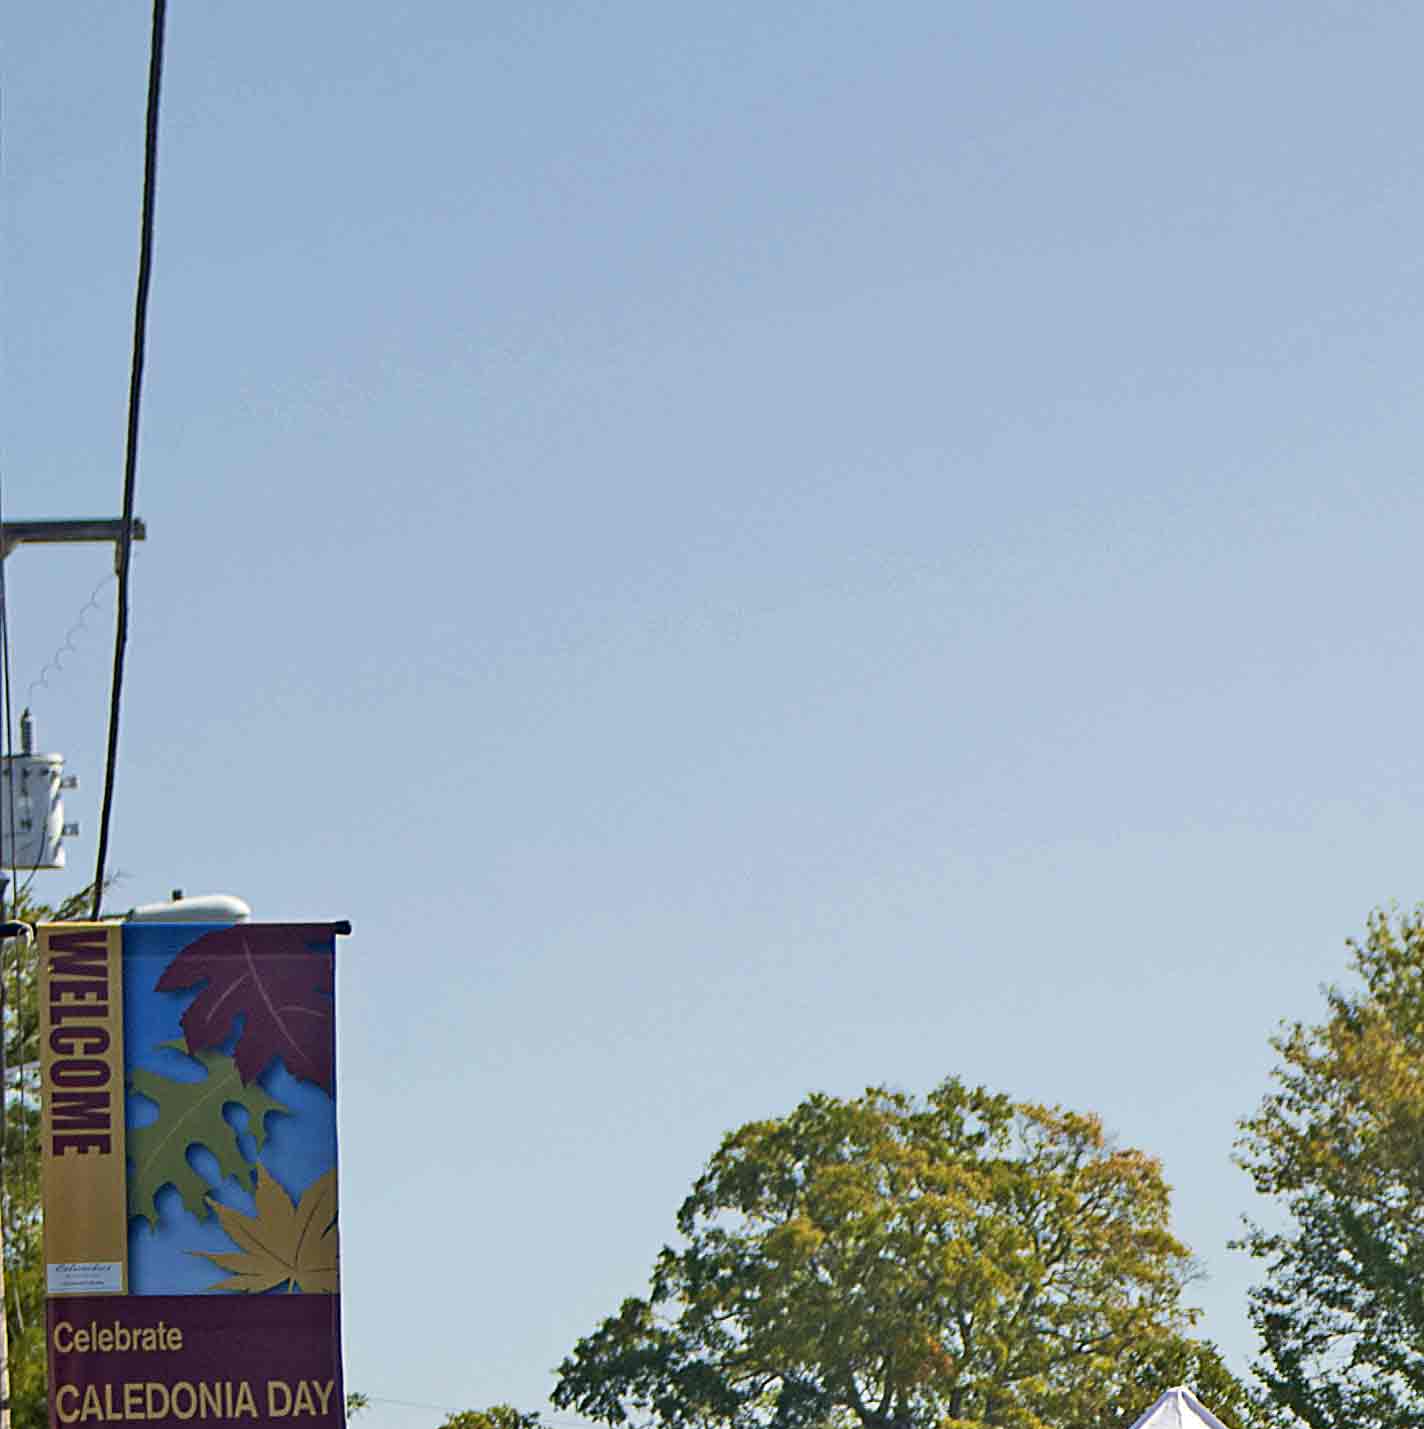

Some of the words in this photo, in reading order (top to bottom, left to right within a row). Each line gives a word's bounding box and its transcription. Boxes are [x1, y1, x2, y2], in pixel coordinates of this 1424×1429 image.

[49, 930, 112, 1157] WELCOME
[53, 1320, 184, 1353] Celebrate
[55, 1380, 259, 1424] CALEDONIA
[266, 1379, 335, 1417] DAY
